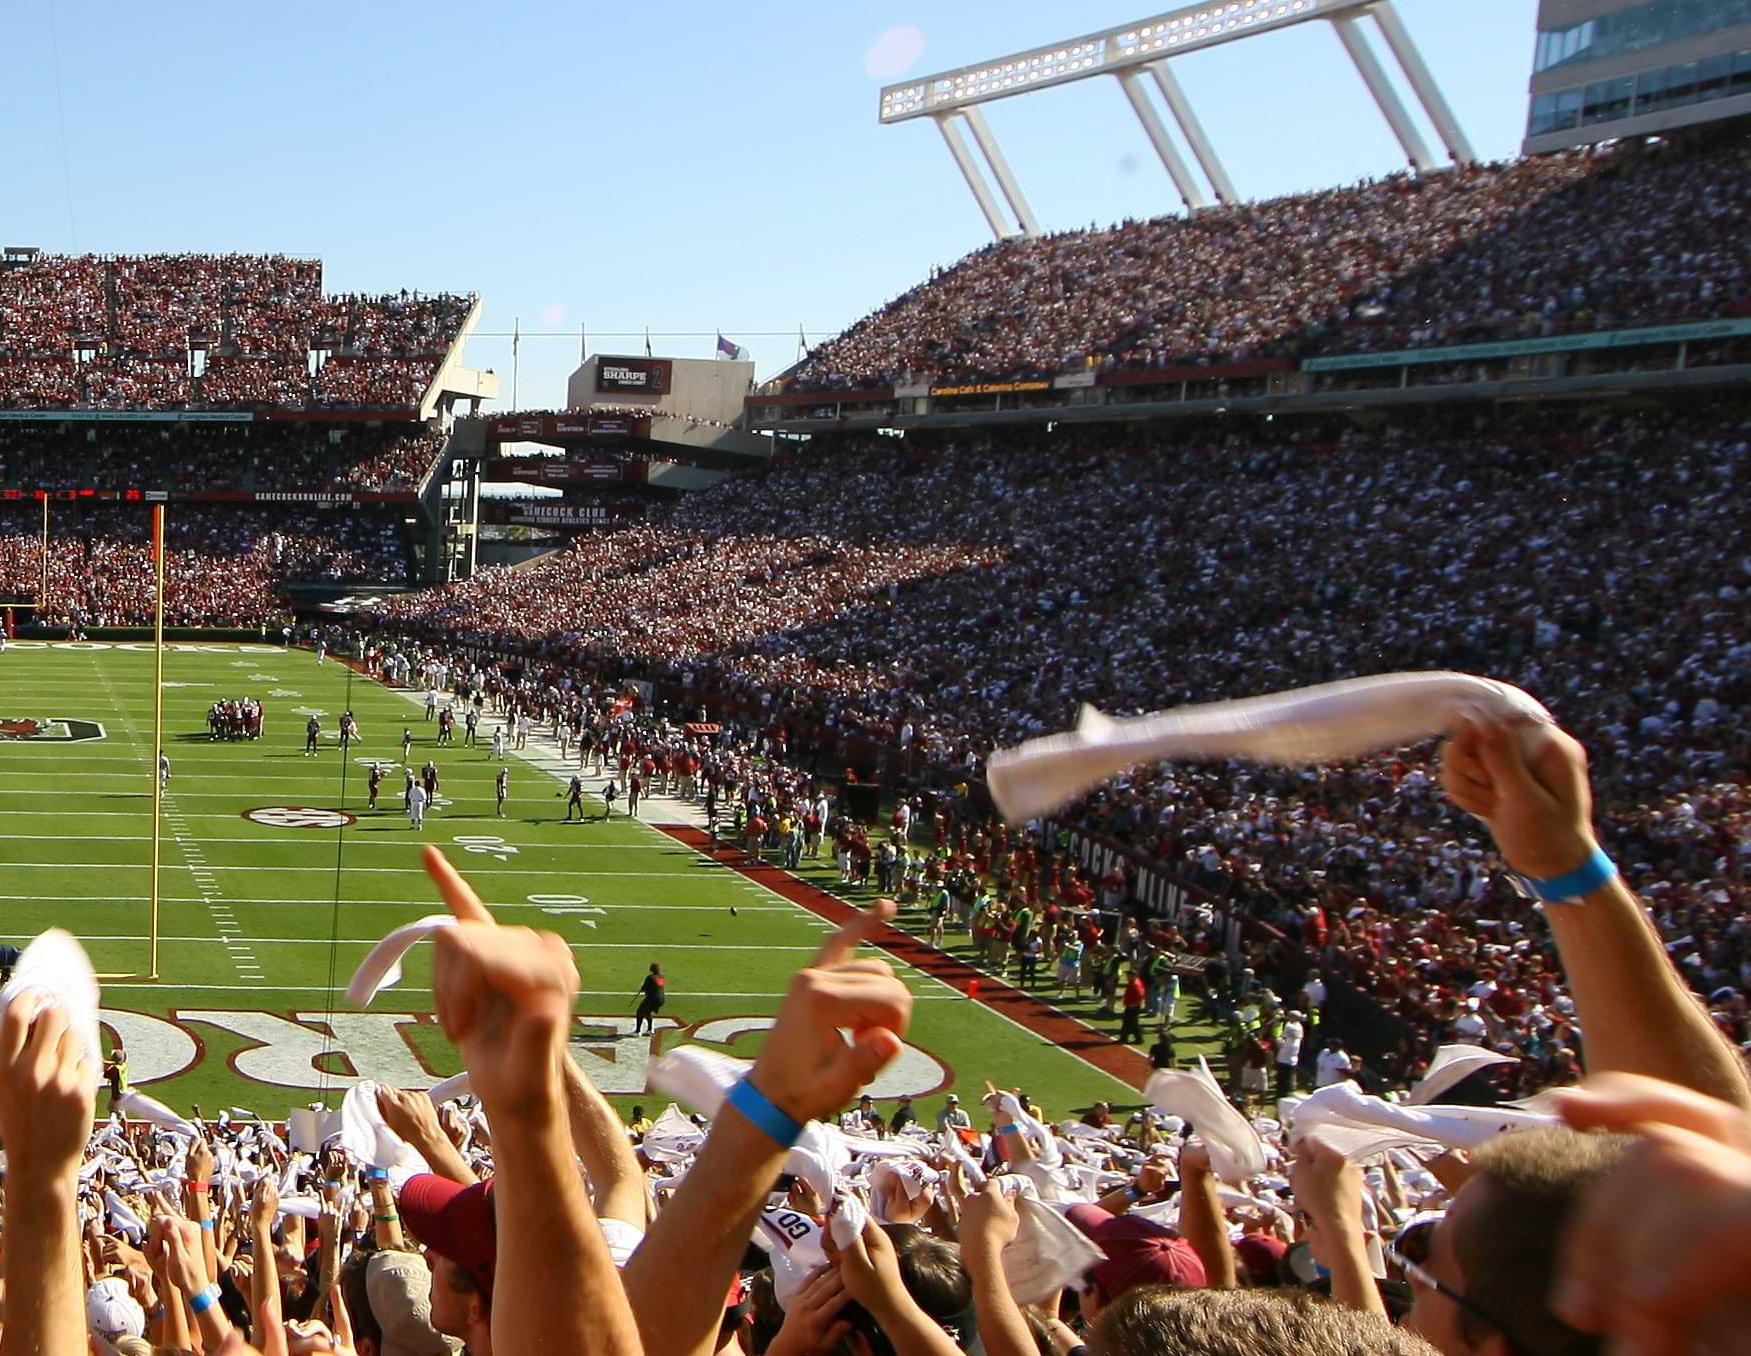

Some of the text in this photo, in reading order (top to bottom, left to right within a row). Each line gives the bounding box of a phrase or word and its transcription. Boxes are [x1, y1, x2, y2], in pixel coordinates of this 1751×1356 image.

[603, 371, 647, 381] SHARPE
[255, 493, 353, 501] GAMECOCKSONLINE.COM
[578, 507, 607, 518] CLUB
